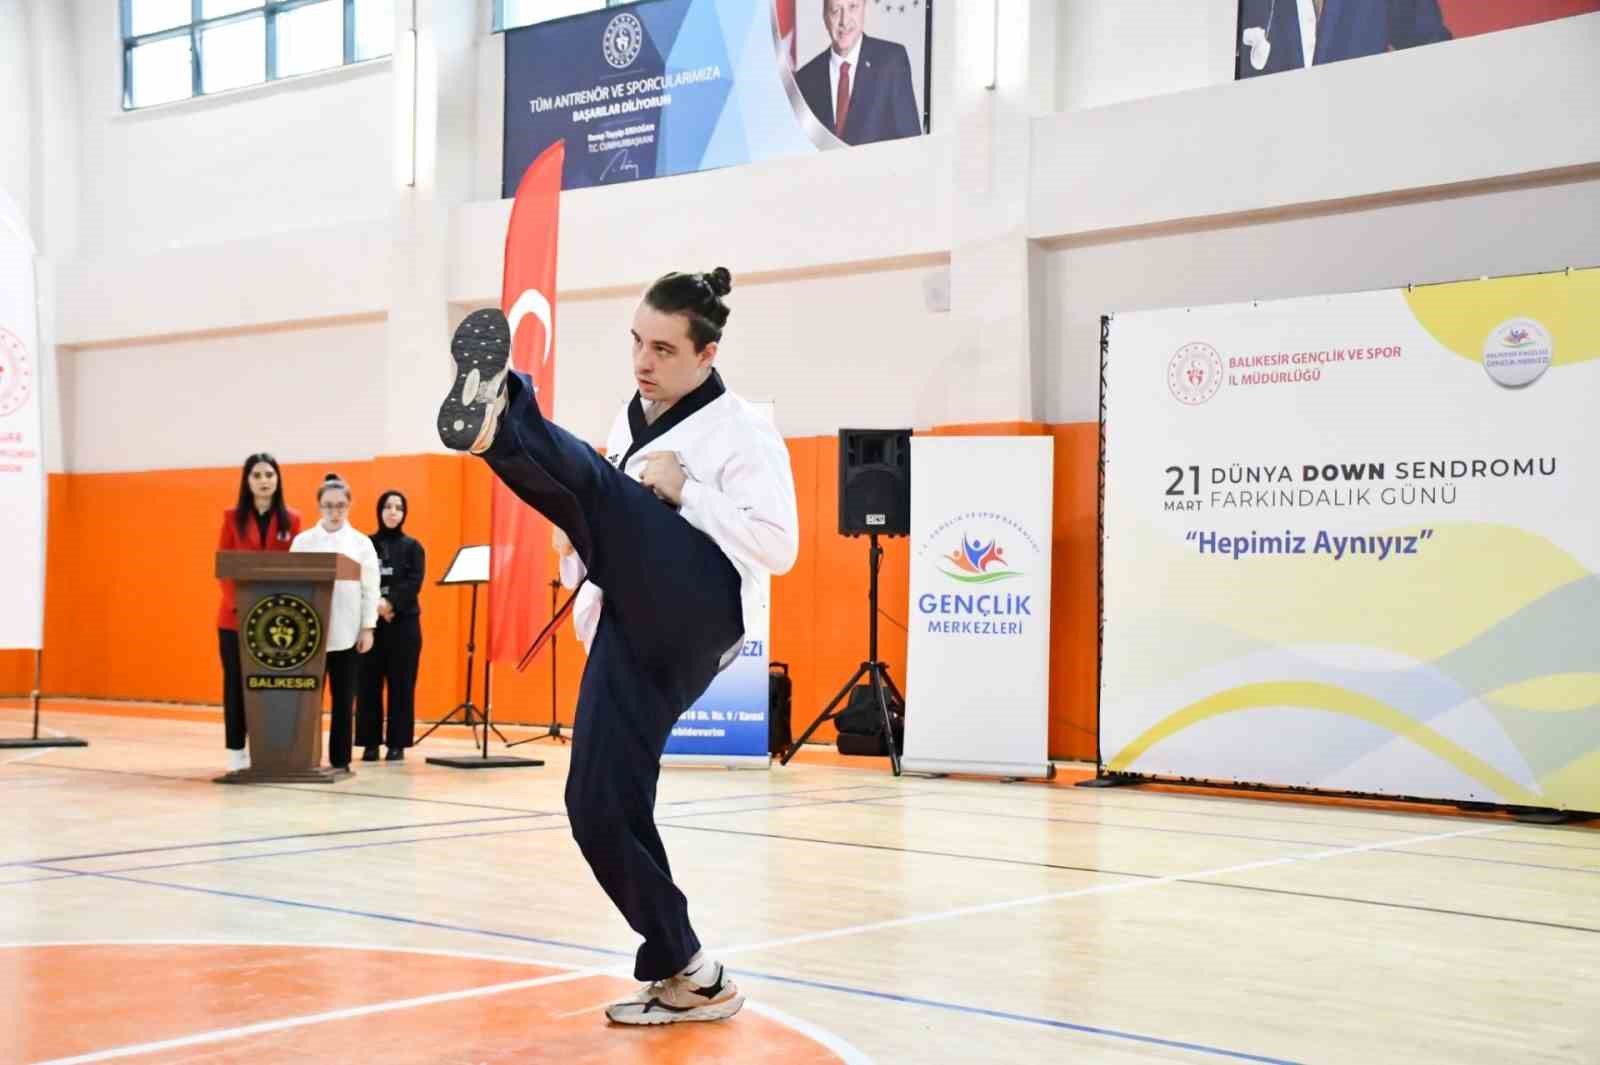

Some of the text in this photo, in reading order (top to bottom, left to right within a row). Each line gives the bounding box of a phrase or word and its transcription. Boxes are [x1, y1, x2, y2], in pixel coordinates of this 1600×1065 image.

[530, 66, 721, 113] TÜM ANTRENÖR VE SPORCULARIMIZA
[573, 94, 672, 122] BAŞARILAR DİLİYORUM
[1229, 345, 1402, 369] BALIKESİR GENÇLİK VE SPOR
[1241, 368, 1321, 385] MÜDÜRLÜĞÜ
[1165, 466, 1200, 496] 21
[1211, 457, 1557, 484] DÜNYA DOWN SENDROMU
[1164, 499, 1202, 512] MART
[1211, 482, 1457, 508] FARKINDALIK GÜNÜ
[918, 593, 1031, 617] GENÇLİK
[927, 620, 1023, 635] MERKEZLERİ
[740, 640, 763, 657] EZİ
